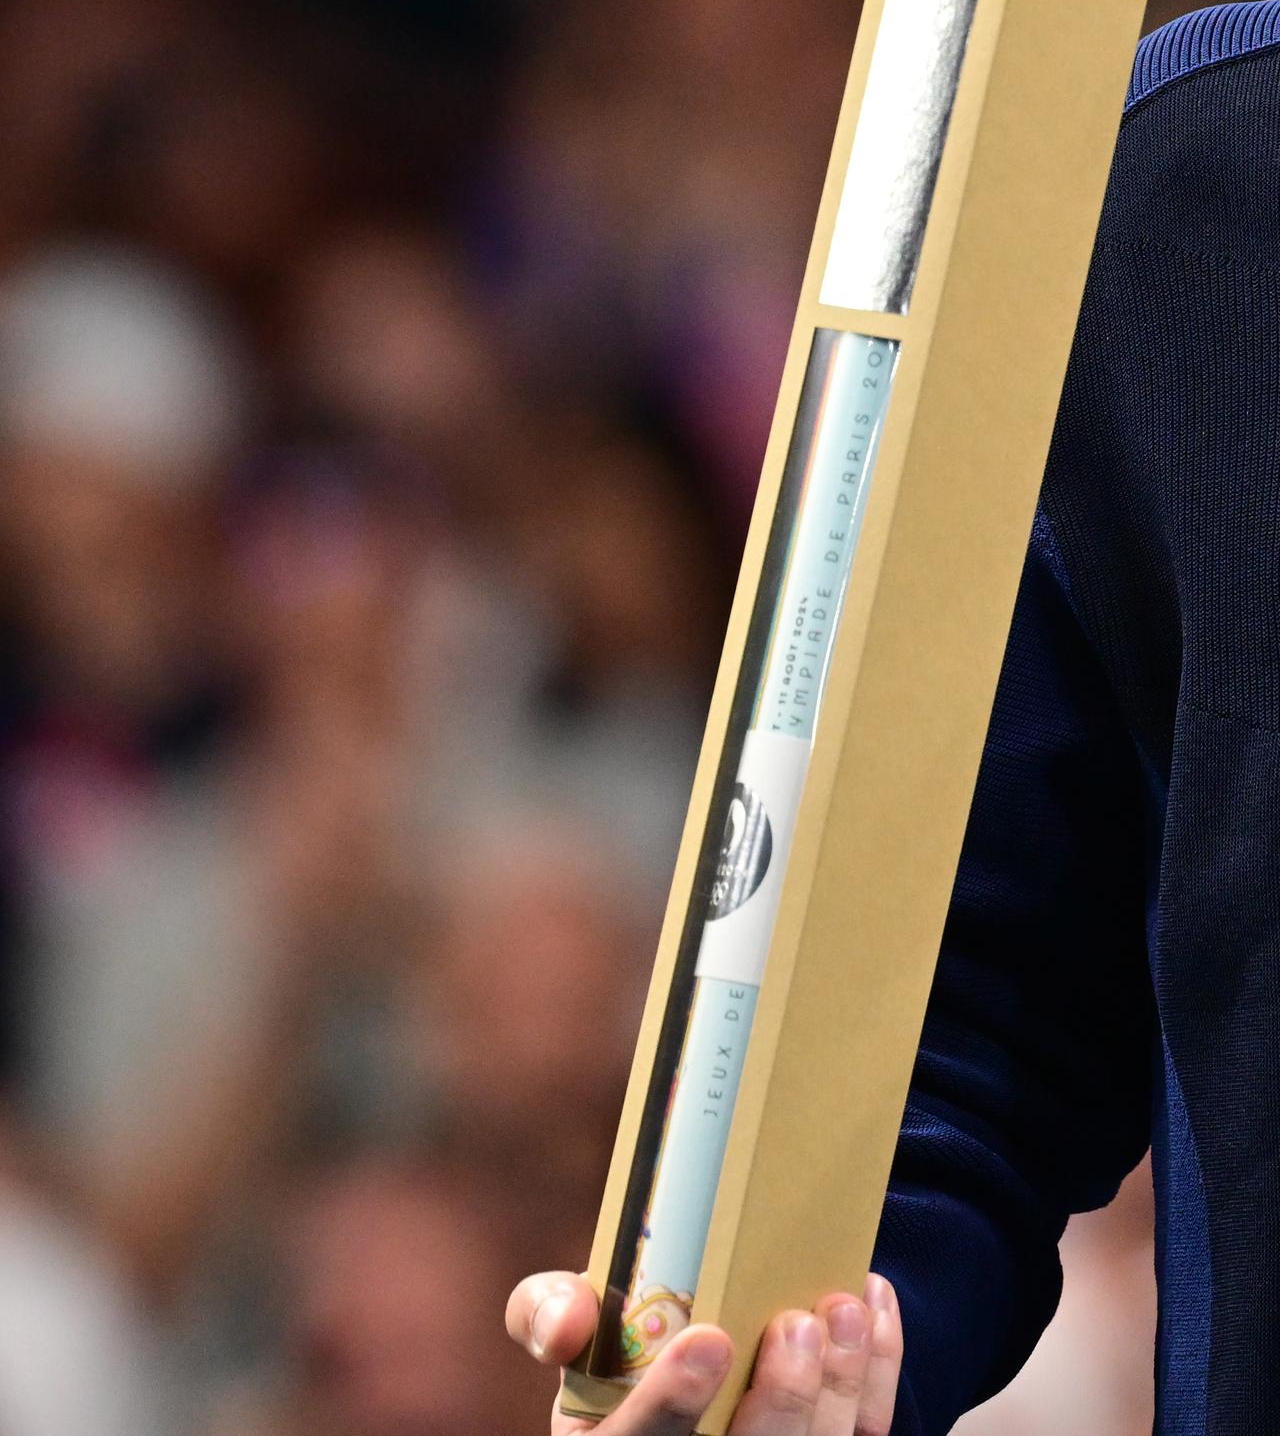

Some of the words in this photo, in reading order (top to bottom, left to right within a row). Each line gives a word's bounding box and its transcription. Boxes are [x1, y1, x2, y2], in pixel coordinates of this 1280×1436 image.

[824, 528, 846, 563] DE
[836, 413, 871, 506] PARIS
[793, 596, 808, 636] 2024
[703, 1044, 733, 1119] JEUX
[724, 988, 745, 1022] DE
